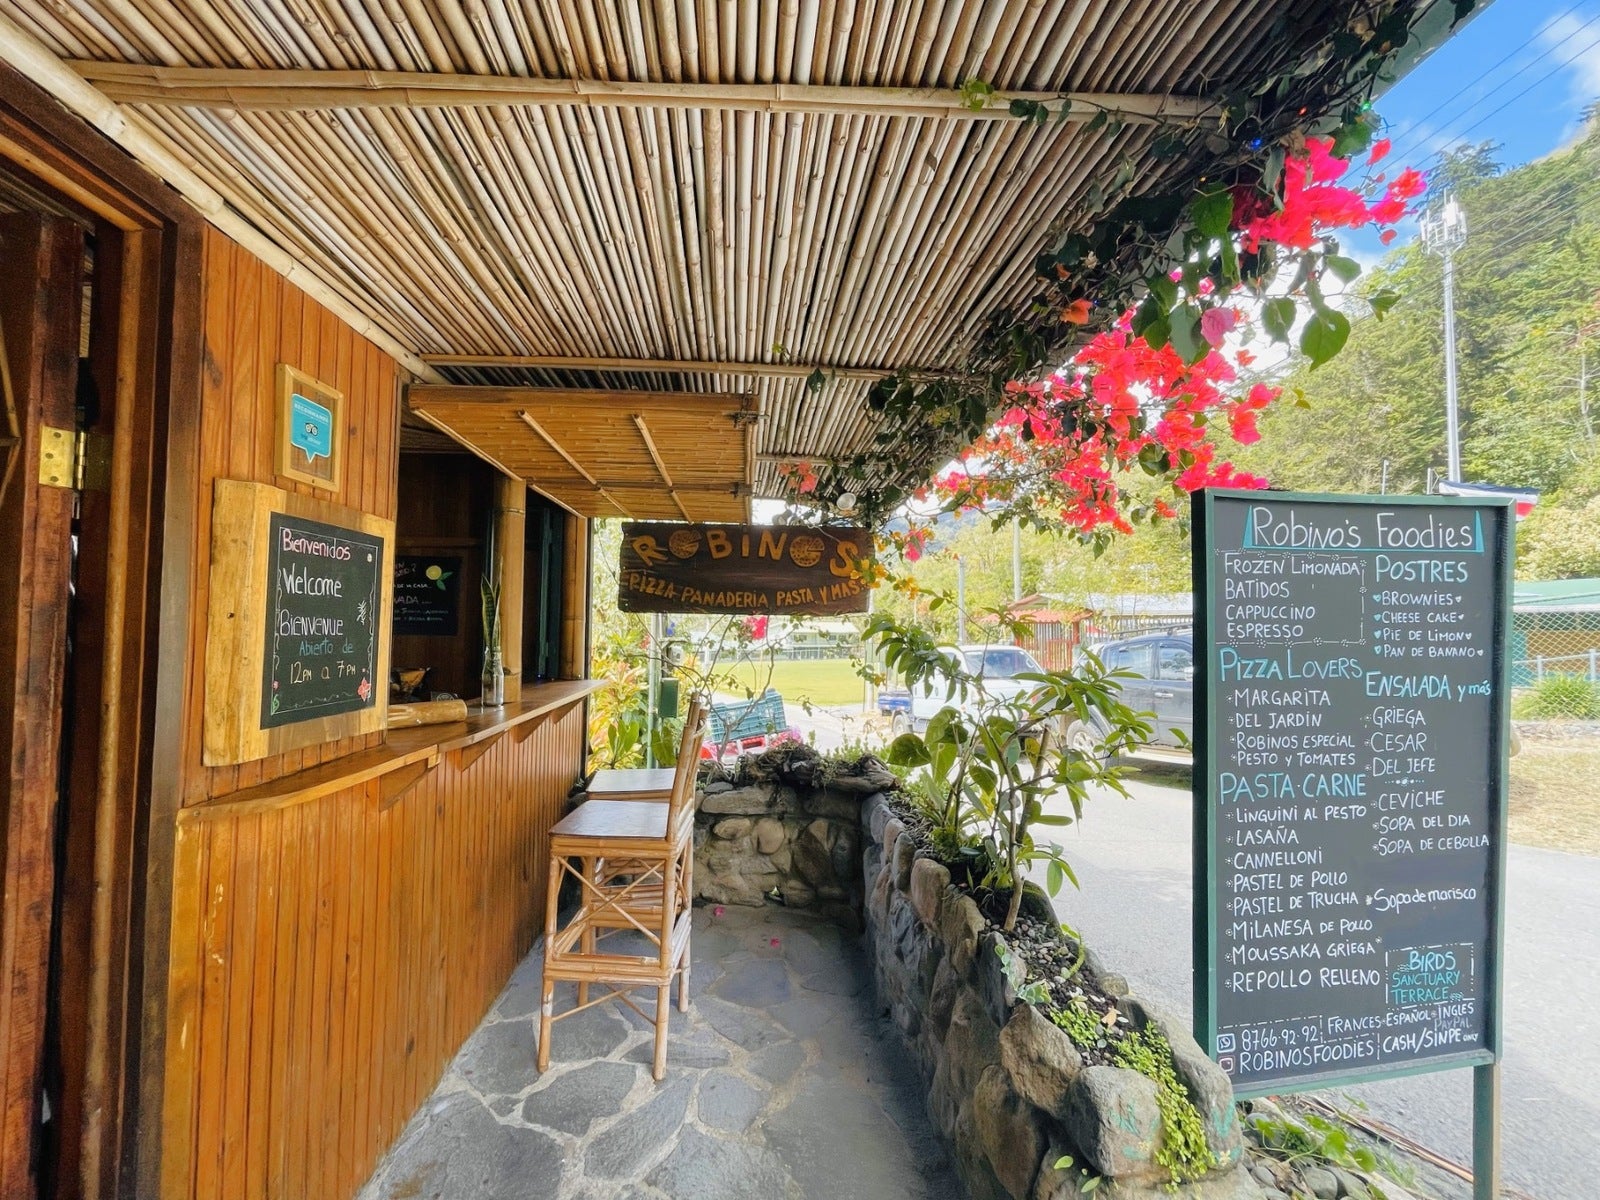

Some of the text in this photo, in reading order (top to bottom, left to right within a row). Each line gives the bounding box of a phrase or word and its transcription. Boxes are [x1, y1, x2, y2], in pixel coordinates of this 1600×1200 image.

[1377, 513, 1473, 548] Foodies
[283, 528, 350, 560] Bienvenidos
[1224, 553, 1360, 576] FROZEN LIMONADA
[1376, 555, 1468, 583] POSTRES
[283, 563, 342, 597] Welcome
[628, 571, 677, 599] PIZZA
[1225, 579, 1289, 599] BATIDOS
[1382, 591, 1453, 606] BROWNIES
[1226, 604, 1315, 619] CAPPUCCINO
[1382, 612, 1457, 623] CHEESE CAKE
[280, 609, 343, 636] BIENVENUE
[1227, 624, 1304, 638] ESPRESSO
[1383, 628, 1465, 641] PIE DE LIMON
[300, 638, 354, 656] Abierto de
[1384, 646, 1475, 657] PAN DE BANANO
[1220, 648, 1363, 682] PIZZA LOVERS
[1366, 671, 1451, 700] ENSALADA
[1235, 688, 1331, 707] MARGARITA
[1236, 713, 1322, 728] DEL JARDIN
[1373, 706, 1426, 725] GRIEGA
[1236, 733, 1355, 750] ROBINOS ESPECIAL
[1371, 733, 1427, 752] CESAR
[1237, 753, 1278, 766] PESTO
[1297, 752, 1356, 766] TOMATES
[1373, 757, 1435, 777] DEL JEFE
[1220, 773, 1366, 804] PASTA CARNE
[1379, 790, 1445, 811] CEVICHE
[1236, 805, 1366, 823] LINGUINI AL PESTO
[1380, 815, 1471, 834] SOPA DEL DIA
[1236, 825, 1299, 846] LASAÑA
[1379, 835, 1489, 856] SOPA DE CEBOLLA
[1234, 847, 1322, 870] CANNELLONI
[1234, 874, 1283, 893] PASTEL
[1290, 875, 1304, 888] DE
[1234, 891, 1358, 916] PASTEL DE TRUCHA
[1233, 919, 1372, 941] MILANESA DE POLLO
[1232, 939, 1375, 965] MOUSSAKA GRIEGA
[1409, 951, 1456, 971] BIRDS
[1233, 967, 1380, 993] REPOLLO RELLENO
[1392, 970, 1460, 987] SANCTUARY
[1391, 987, 1449, 1004] TERRACE
[1328, 1002, 1474, 1034] FRANCES ESPAÑOL INGLES
